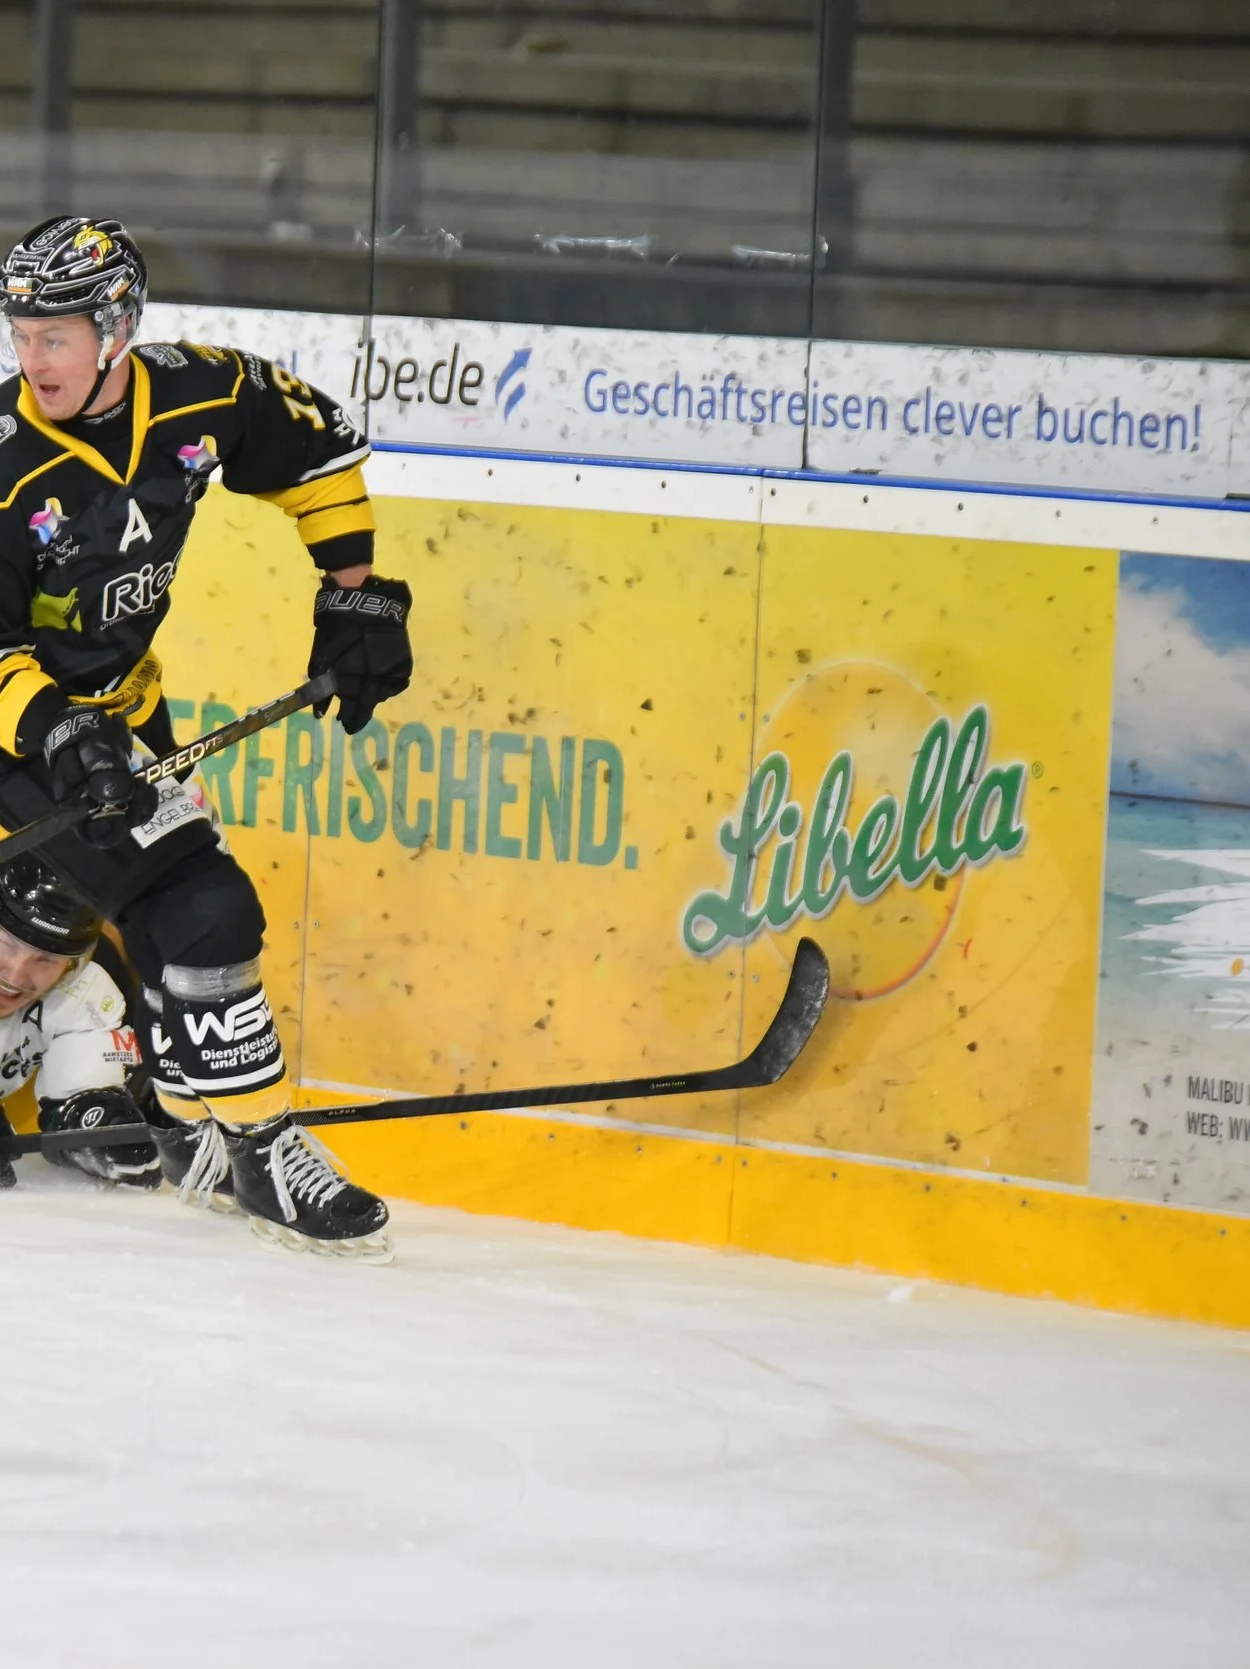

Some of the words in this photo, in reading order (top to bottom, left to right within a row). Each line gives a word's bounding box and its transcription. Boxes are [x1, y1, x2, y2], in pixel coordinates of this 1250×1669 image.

[350, 337, 485, 406] ibe.de
[583, 368, 890, 432] Geschäftsreisen
[902, 390, 1024, 442] clever
[1035, 398, 1204, 452] buchen!
[118, 497, 154, 554] A
[683, 704, 1026, 955] Libella
[22, 999, 44, 1033] A
[210, 1057, 239, 1071] und
[1187, 1075, 1245, 1105] MALIBU
[1186, 1109, 1224, 1138] WEB:
